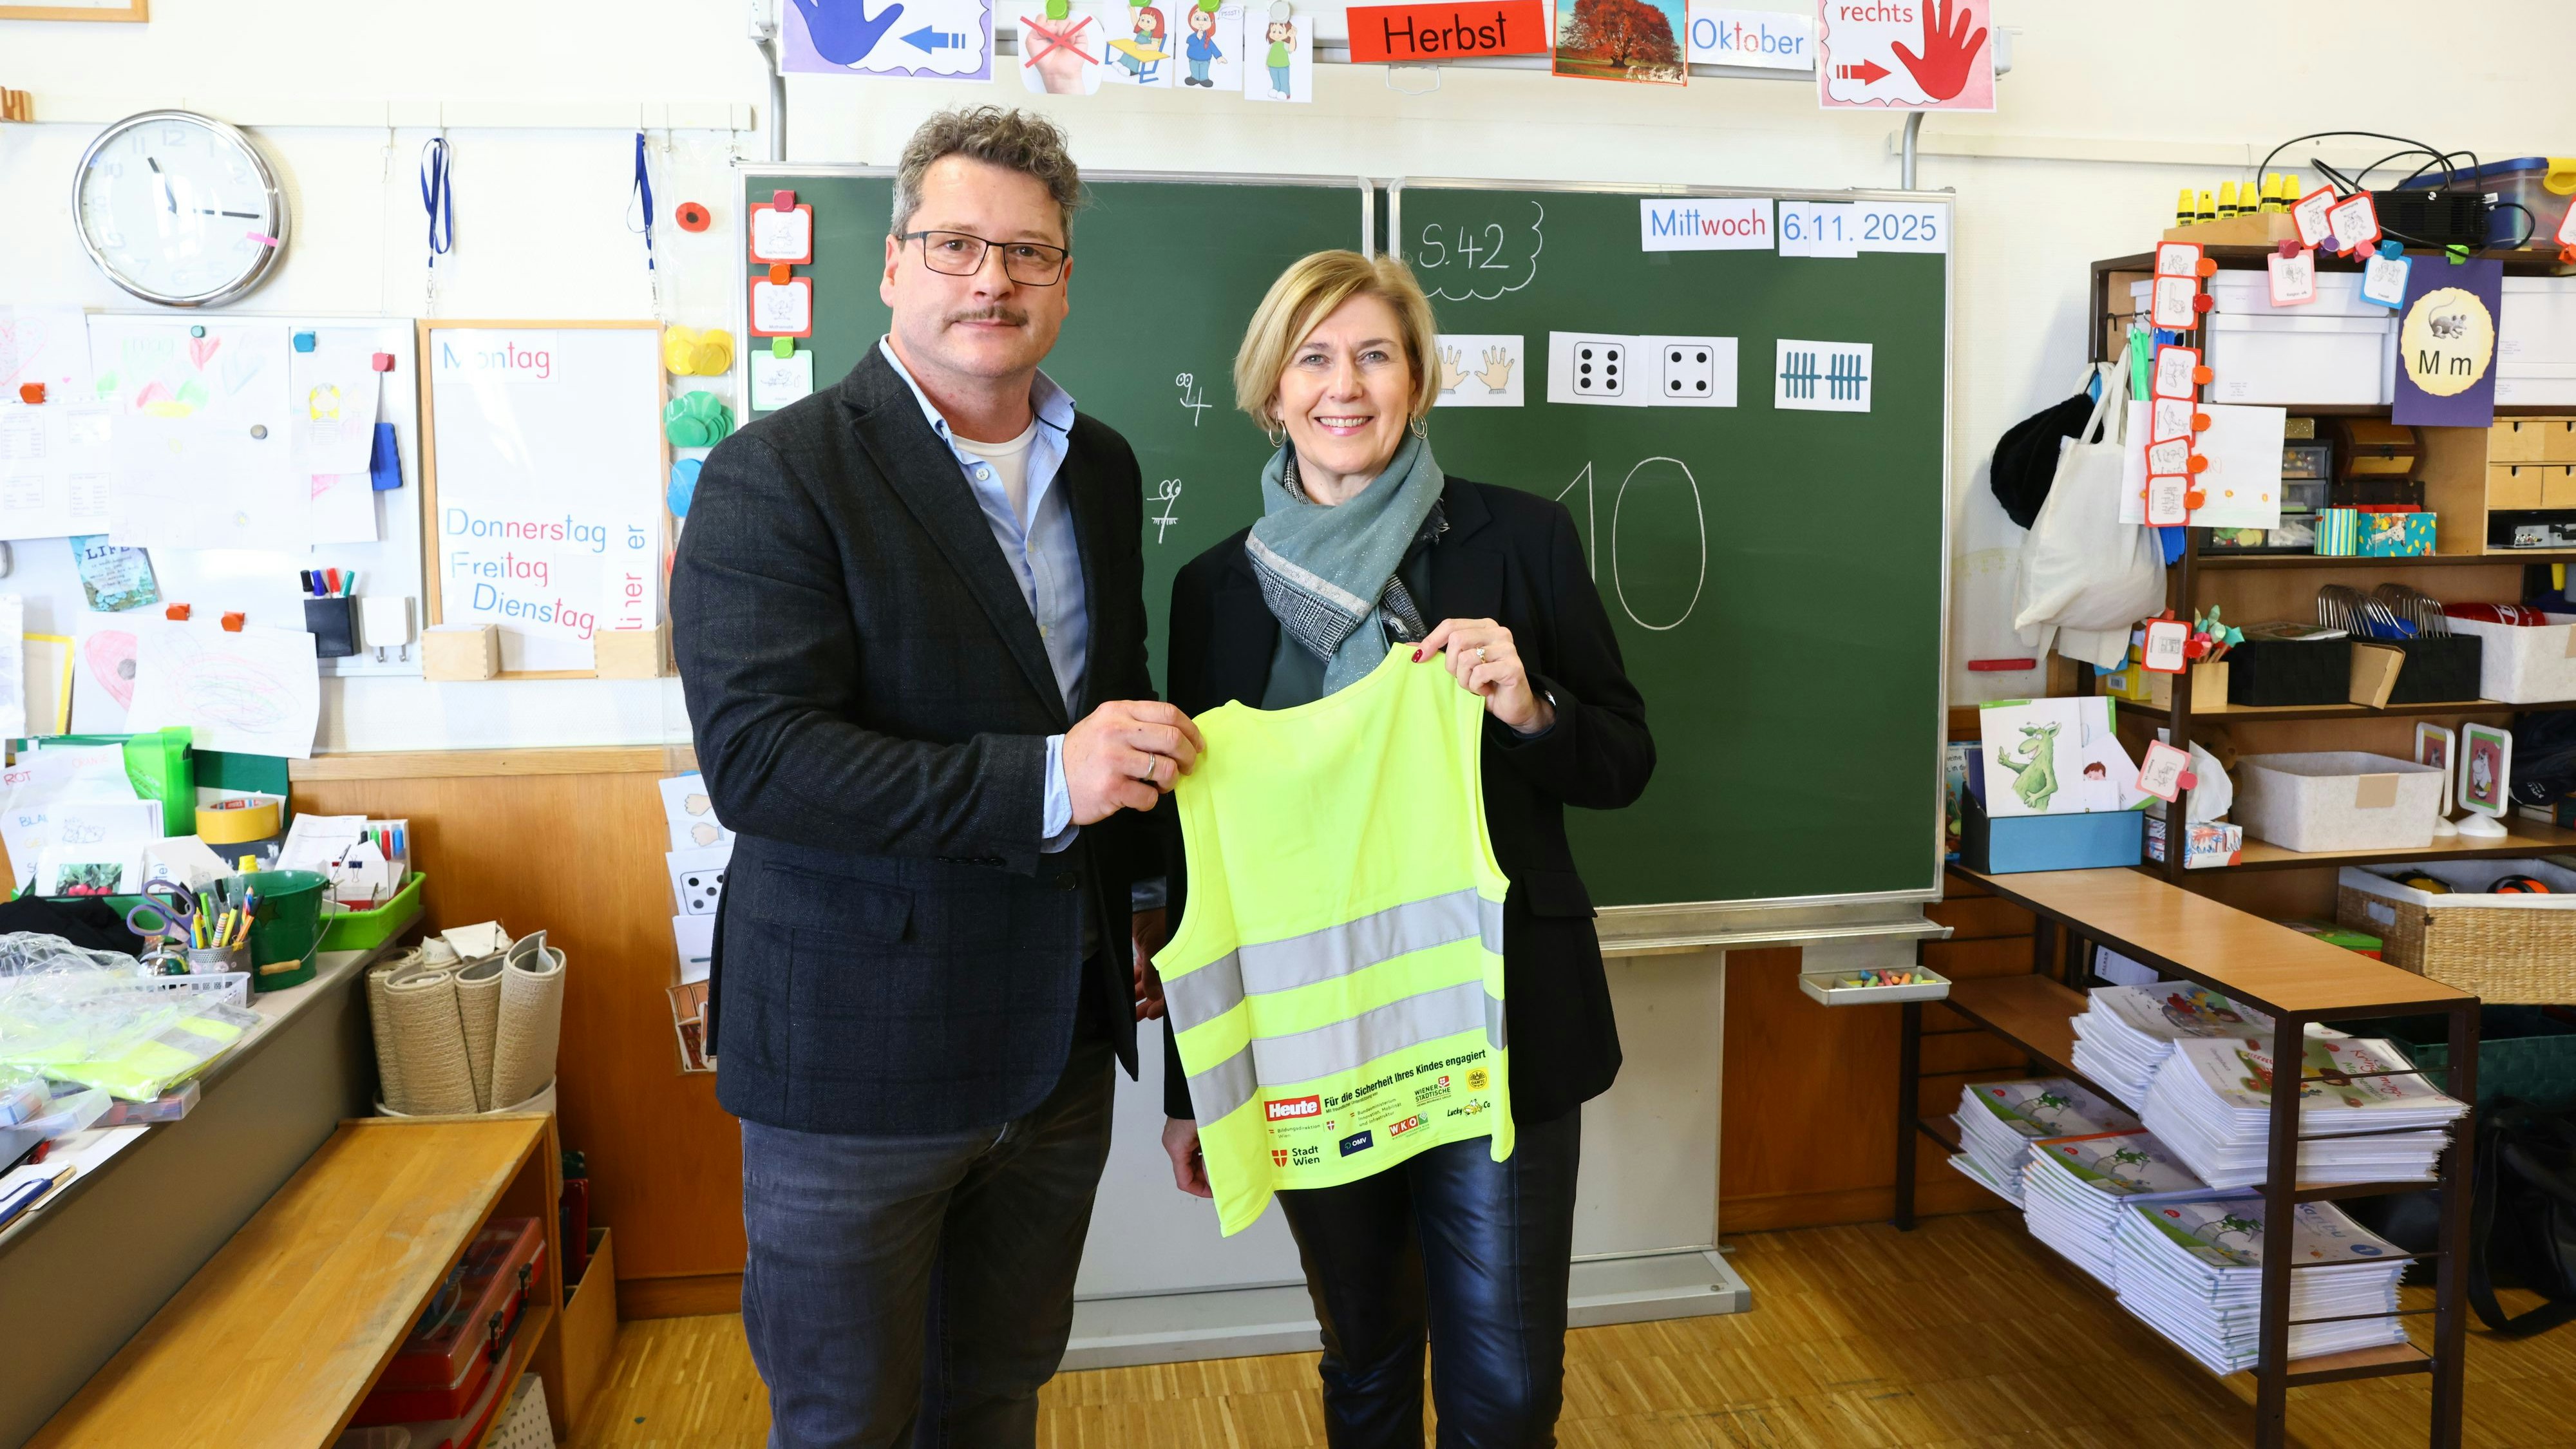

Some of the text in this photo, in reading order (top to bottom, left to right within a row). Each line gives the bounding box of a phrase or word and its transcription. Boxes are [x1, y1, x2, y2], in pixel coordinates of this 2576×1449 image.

[1841, 0, 1913, 23] rechts
[1383, 11, 1506, 54] Herbst
[1692, 18, 1804, 55] Oktober
[1652, 208, 1765, 236] Mittwoch
[1864, 213, 1937, 242] 2025
[2419, 350, 2471, 375] M m
[446, 507, 606, 553] Donnerstag
[451, 551, 548, 587] Freitag
[473, 582, 595, 640] Dienstag
[3, 770, 32, 786] ROT
[1324, 1049, 1486, 1108] Für die Sicherheit Ihres Kindes engagiert
[1414, 1084, 1438, 1095] WIENER
[1269, 1101, 1318, 1118] Heute
[1358, 1098, 1396, 1115] Bundesministerium
[1447, 1108, 1463, 1117] Lucky
[1277, 1124, 1320, 1133] Bildungsdirektion
[1390, 1117, 1417, 1135] WKO
[1352, 1137, 1367, 1146] OMV
[1292, 1146, 1318, 1157] Stadt
[1293, 1157, 1320, 1166] Wien
